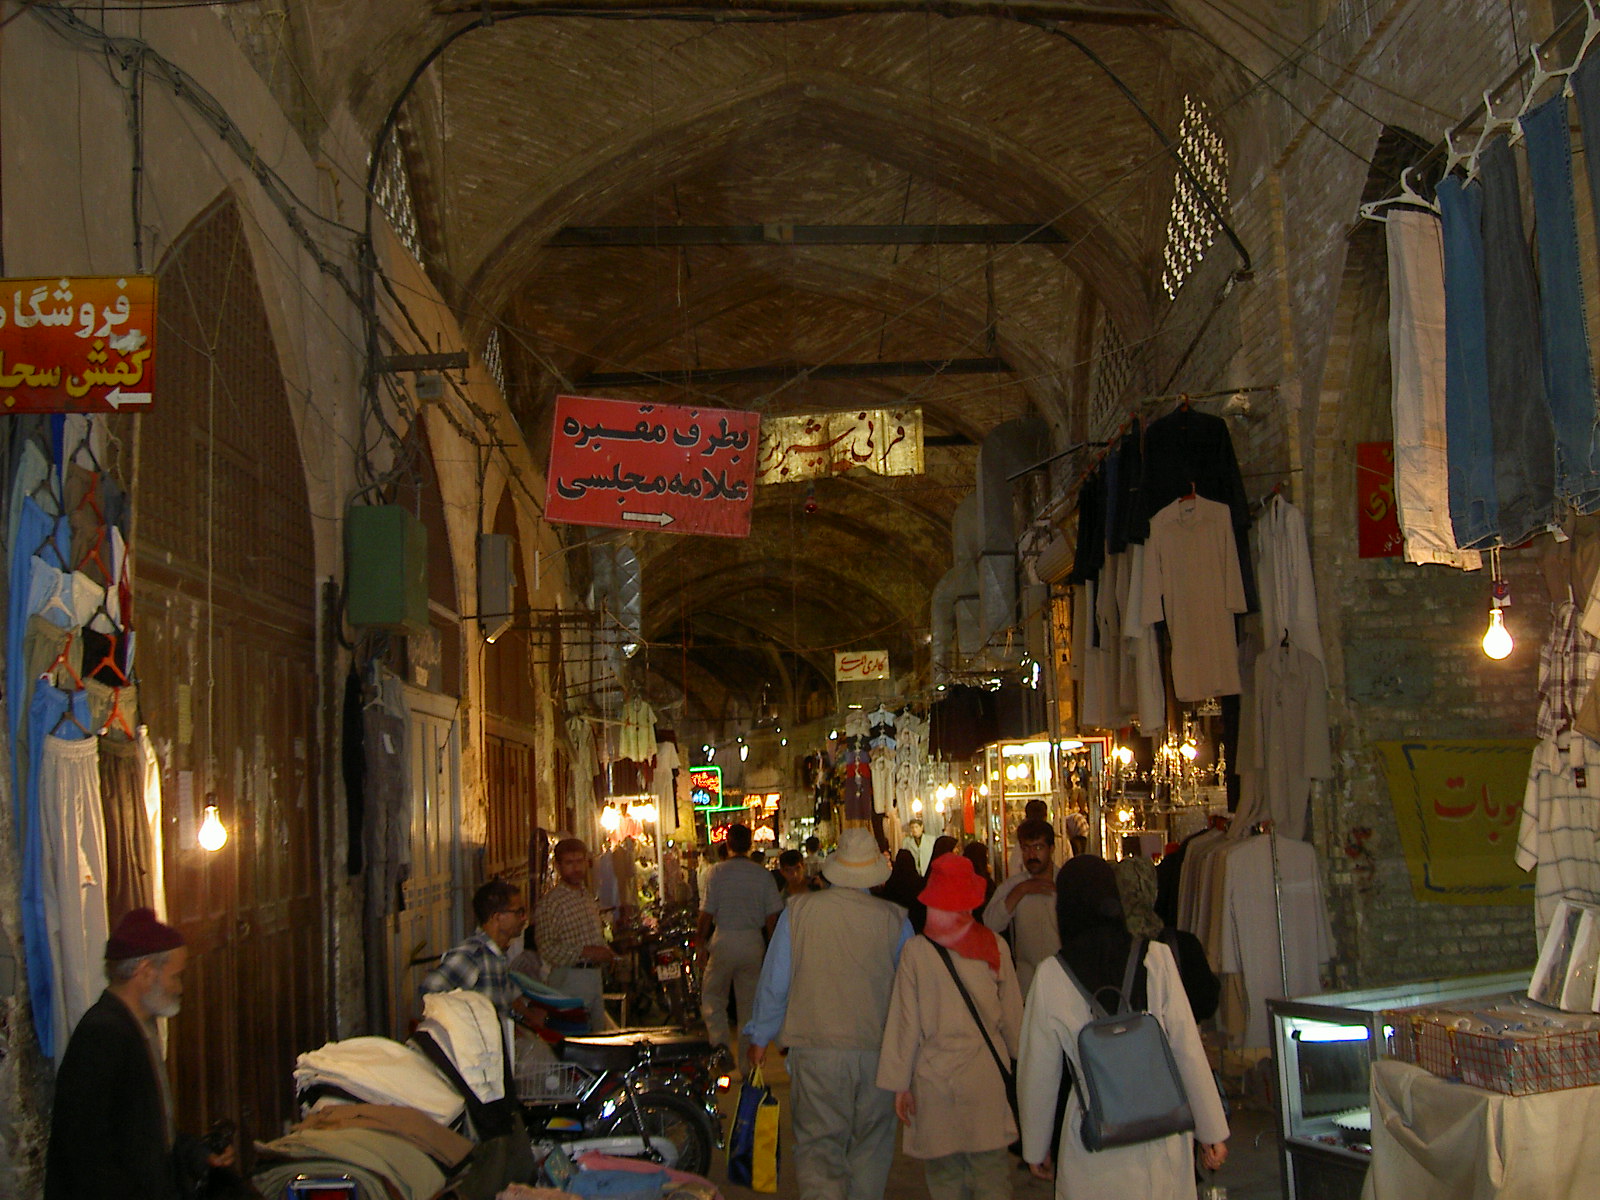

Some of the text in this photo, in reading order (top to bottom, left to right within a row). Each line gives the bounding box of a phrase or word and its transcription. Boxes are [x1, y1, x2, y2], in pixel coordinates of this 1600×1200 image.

[66, 339, 152, 398] کفش
[563, 404, 750, 464] بطرف مقبره
[850, 411, 906, 463] فرنی
[556, 461, 749, 504] علامه مجلسی
[1434, 776, 1523, 842] وبات
